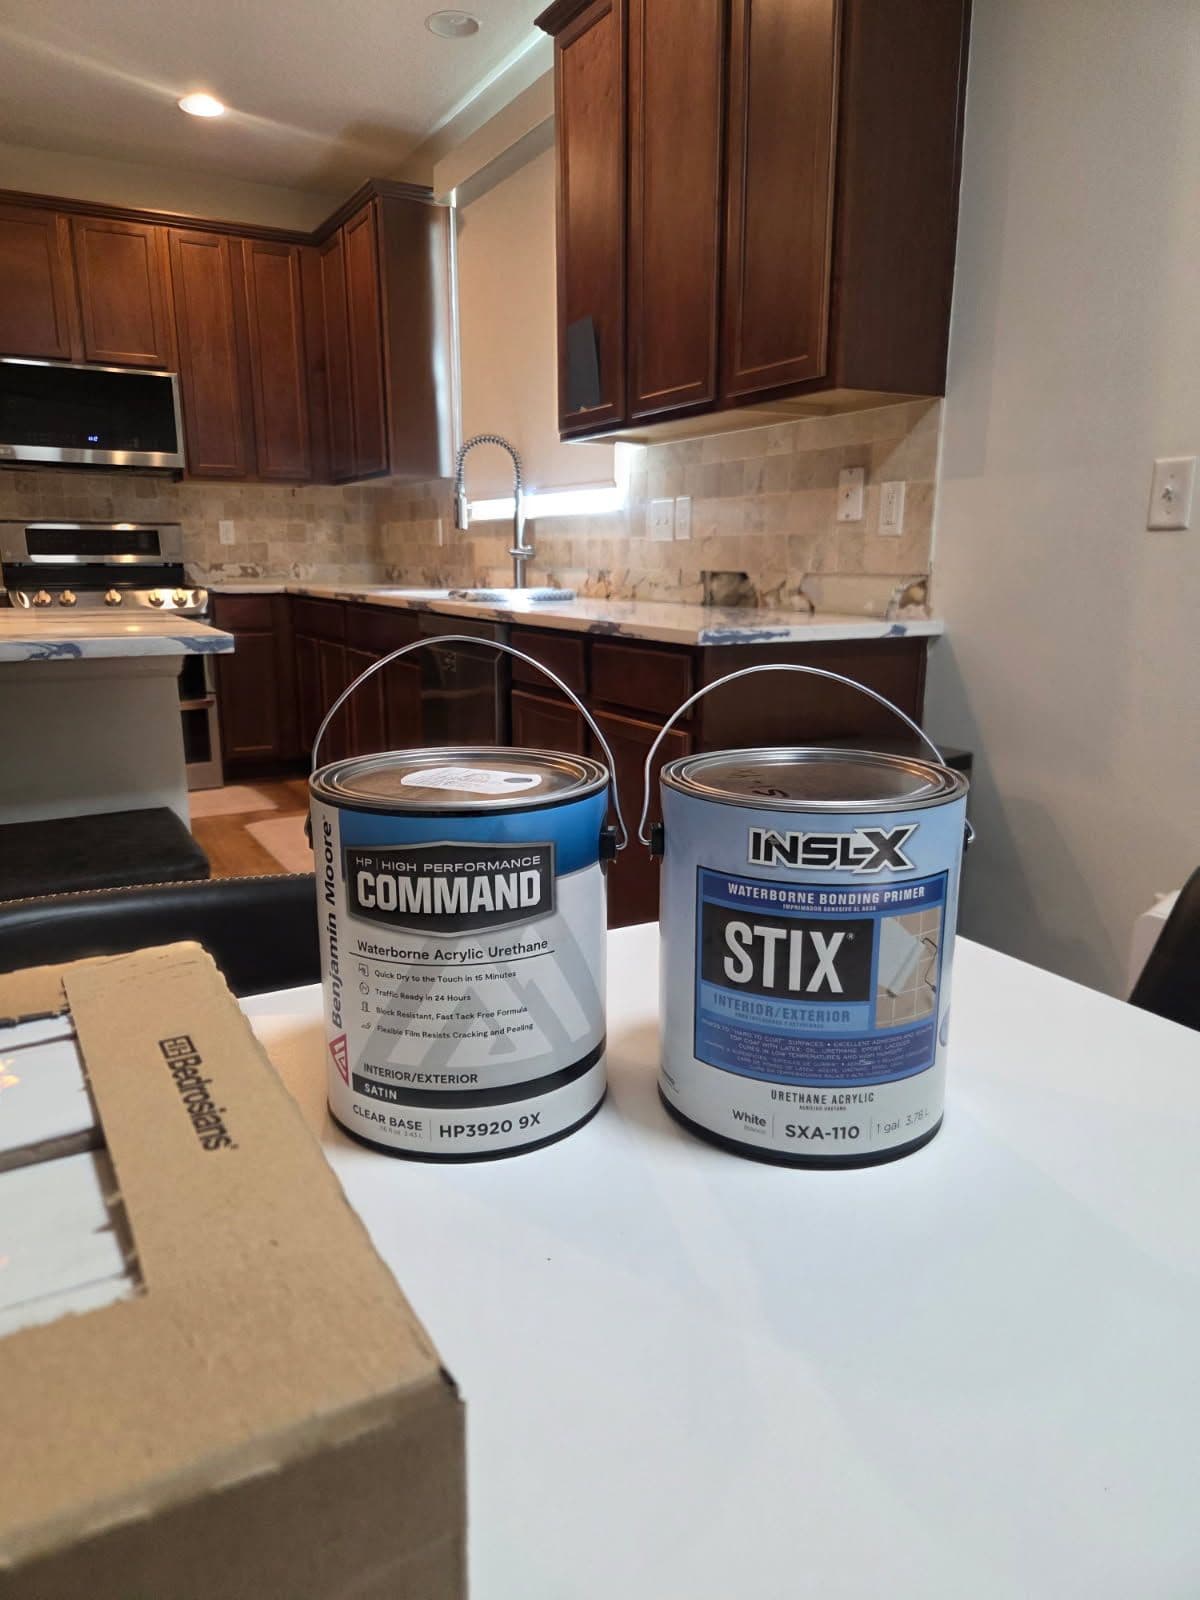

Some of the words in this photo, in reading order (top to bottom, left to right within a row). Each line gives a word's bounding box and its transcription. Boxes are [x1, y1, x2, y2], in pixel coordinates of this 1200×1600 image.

[321, 820, 336, 906] Moore
[356, 856, 372, 866] HP
[382, 860, 417, 871] HIGH
[424, 856, 541, 873] PERFORMANCE
[357, 870, 542, 914] COMMAND
[728, 882, 814, 904] WATERBORNE
[819, 887, 880, 905] BONDING
[883, 886, 925, 902] PRIMER
[357, 939, 429, 960] Waterborne
[435, 941, 483, 963] Acrylic
[488, 940, 548, 958] Urethane
[723, 921, 846, 993] STIX
[326, 913, 343, 1029] Benjamin
[374, 969, 394, 979] Quick
[397, 973, 410, 982] Dry
[485, 971, 516, 980] Minutes
[375, 988, 399, 998] Traffic
[400, 992, 424, 1002] Ready
[426, 993, 433, 1001] in
[376, 1006, 395, 1016] Block
[497, 1006, 528, 1017] Formula
[405, 1029, 420, 1037] Film
[452, 1030, 488, 1039] Cracking
[490, 1028, 505, 1036] and
[363, 1063, 478, 1084] INTERIOR/EXTERIOR
[167, 1054, 232, 1151] Bedrosians
[363, 1083, 397, 1100] SATIN
[771, 1089, 826, 1105] URETHANE
[832, 1092, 874, 1105] ACRYLIC
[352, 1104, 386, 1124] CLEAR
[389, 1117, 423, 1131] BASE
[440, 1120, 512, 1138] HP3920
[518, 1111, 541, 1129] 9X
[732, 1108, 767, 1126] White
[785, 1124, 860, 1140] SXA-110
[883, 1119, 900, 1134] gal
